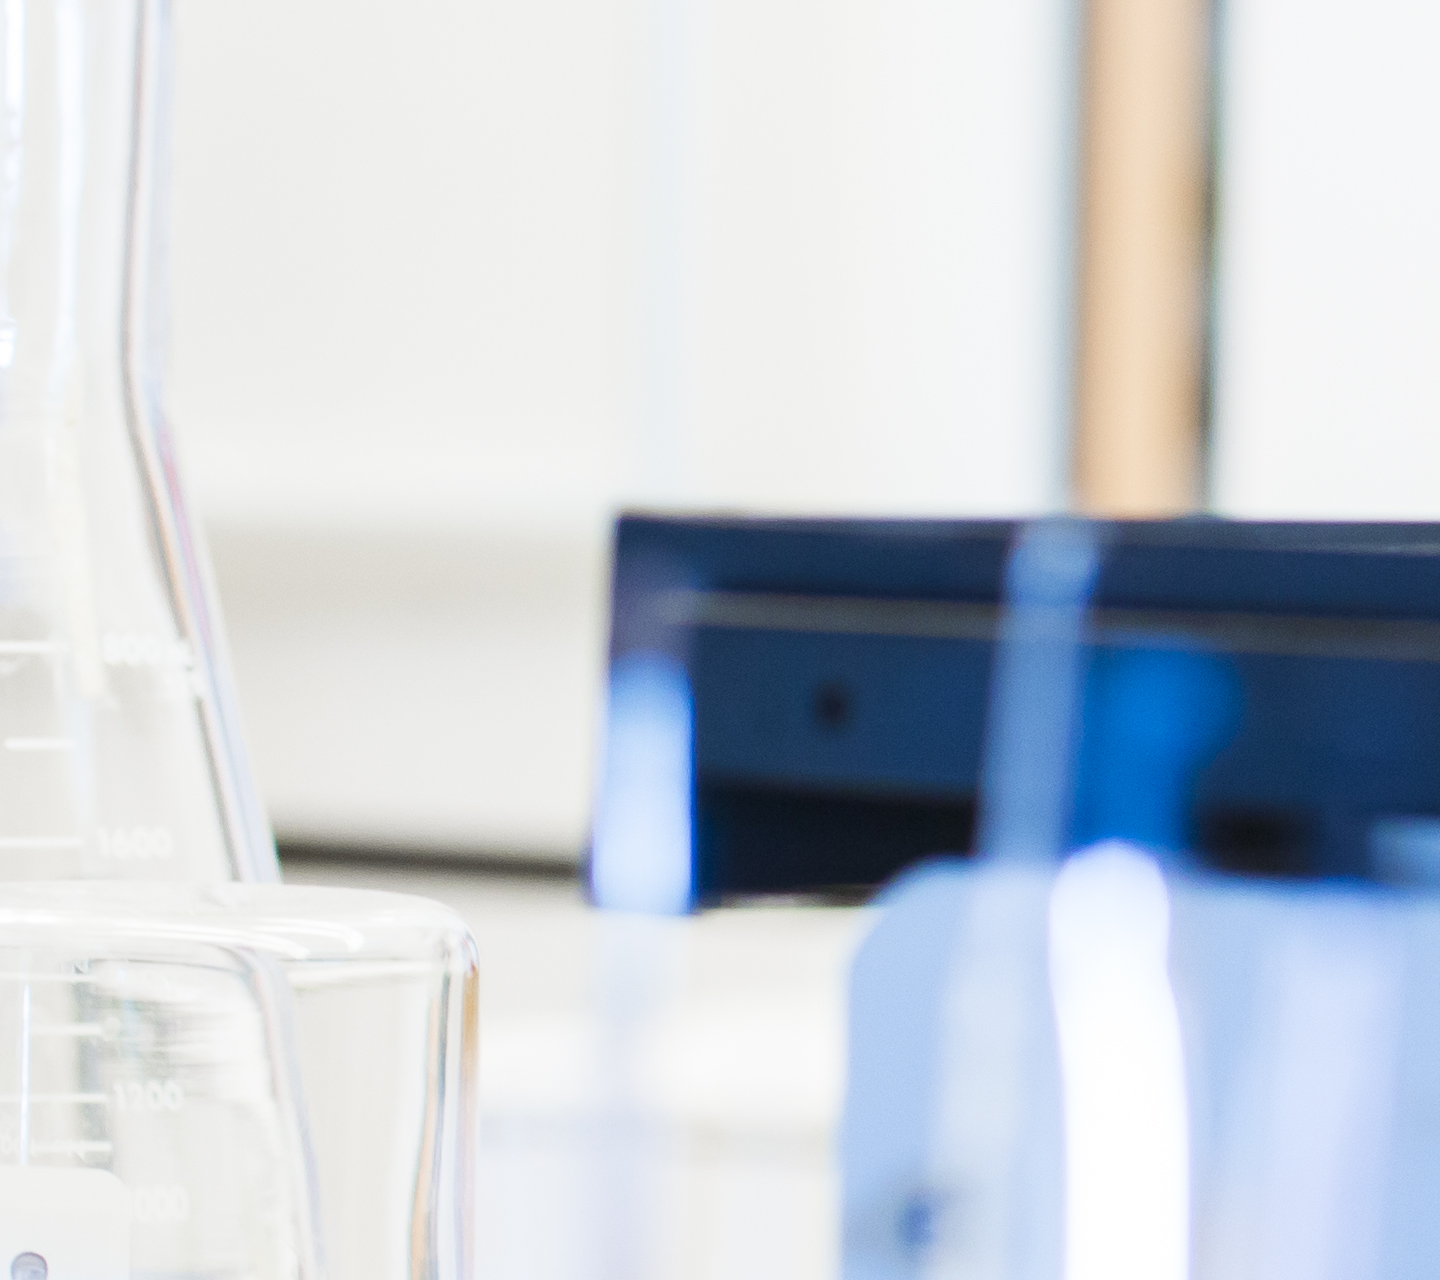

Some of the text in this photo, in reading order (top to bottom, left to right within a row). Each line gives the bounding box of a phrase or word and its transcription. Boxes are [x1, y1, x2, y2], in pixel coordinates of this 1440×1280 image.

[96, 825, 173, 860] 1600
[113, 1081, 185, 1113] 1200
[134, 1184, 191, 1223] 000
